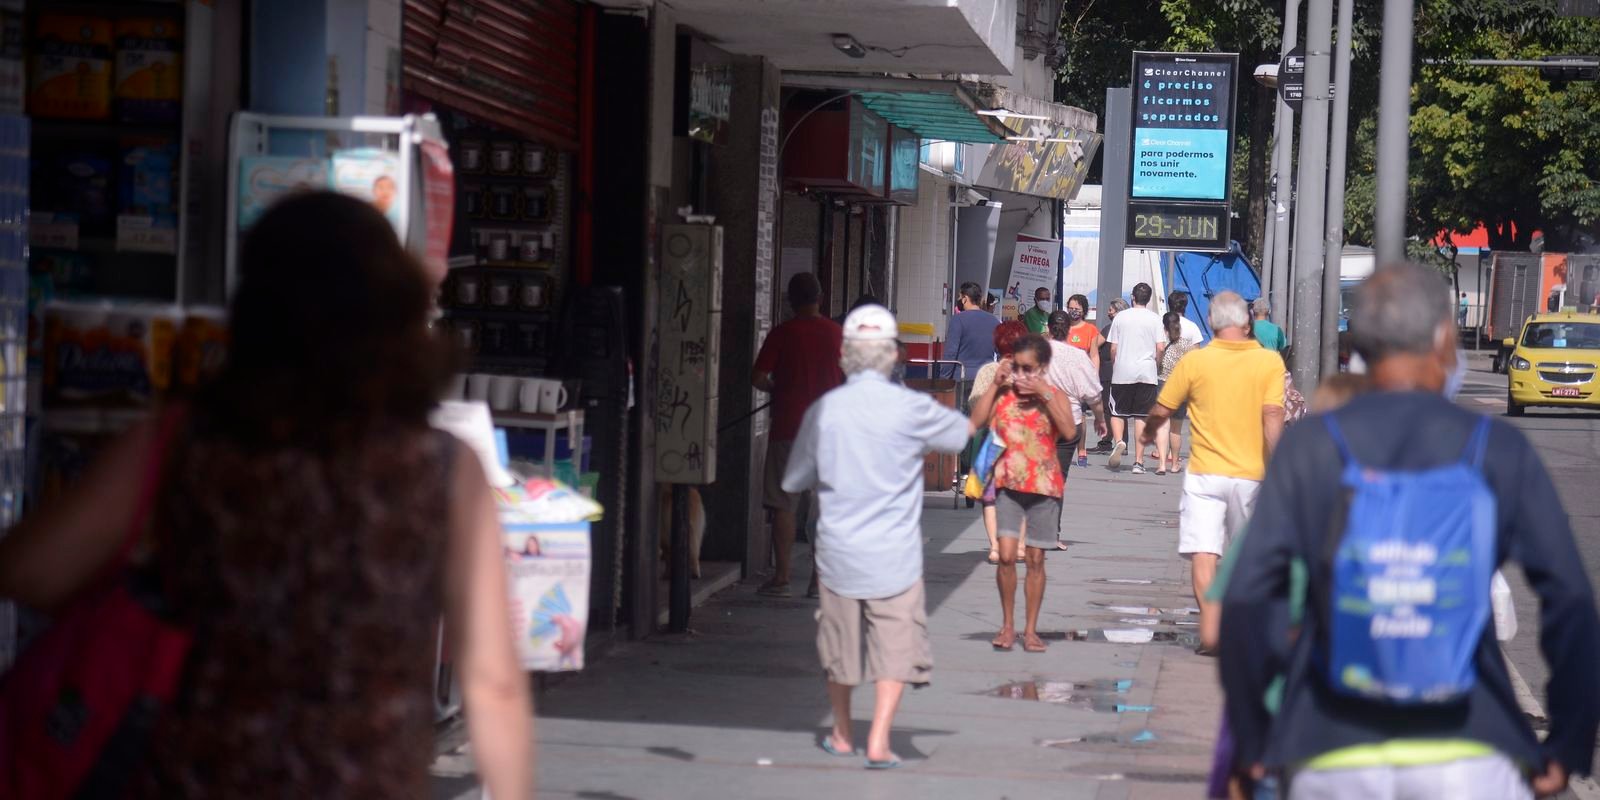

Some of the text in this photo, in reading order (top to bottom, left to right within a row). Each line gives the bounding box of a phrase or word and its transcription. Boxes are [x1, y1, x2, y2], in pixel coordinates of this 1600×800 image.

[1143, 80, 1213, 91] é preciso
[1143, 96, 1210, 106] ficarmos
[1142, 113, 1219, 122] separados
[1140, 150, 1214, 159] para podermos
[1160, 159, 1180, 168] unir
[1140, 170, 1197, 178] novamente.
[1134, 214, 1218, 239] 29-JUN
[1020, 254, 1050, 268] ENTREGA
